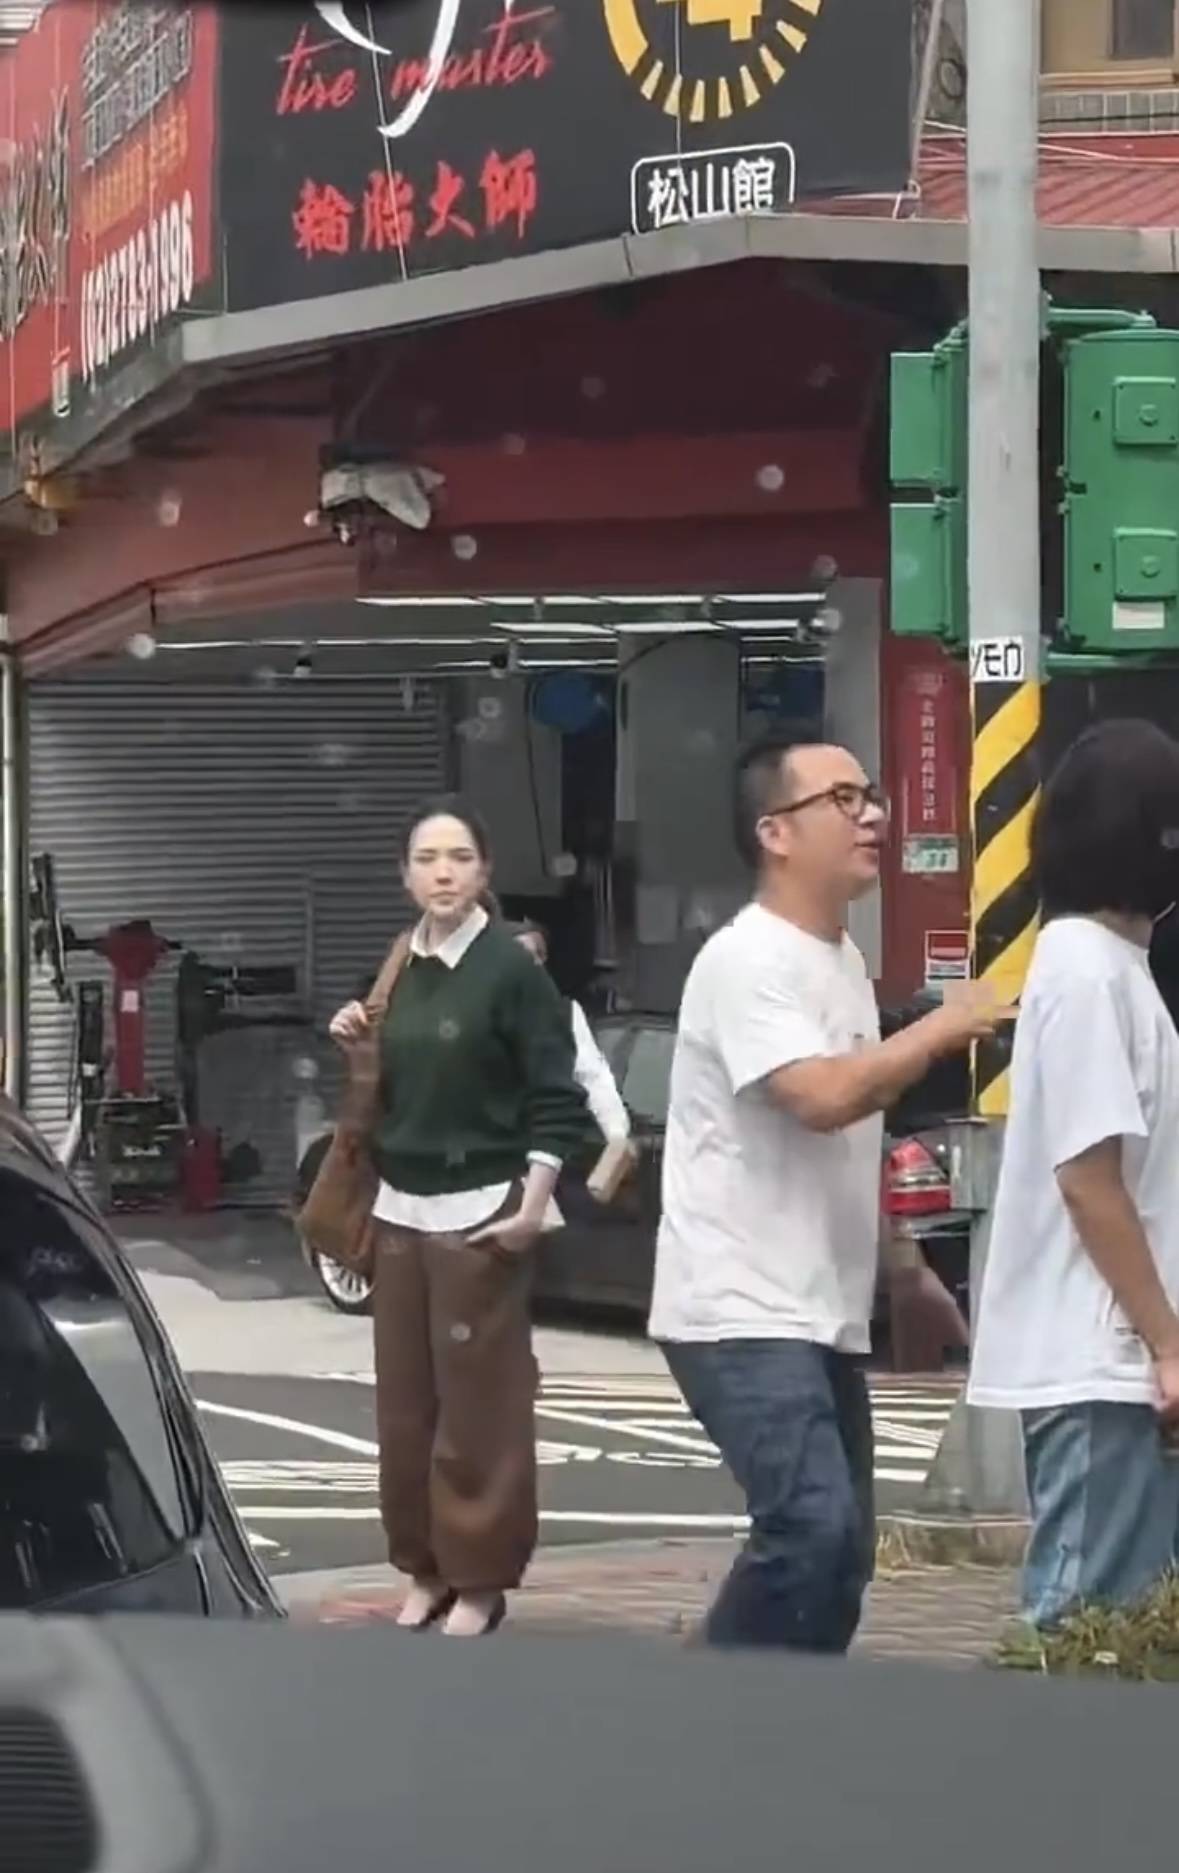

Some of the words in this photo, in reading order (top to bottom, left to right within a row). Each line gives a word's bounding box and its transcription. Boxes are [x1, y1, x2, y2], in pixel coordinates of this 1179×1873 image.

[276, 22, 357, 116] tire
[647, 156, 775, 229] 松山館
